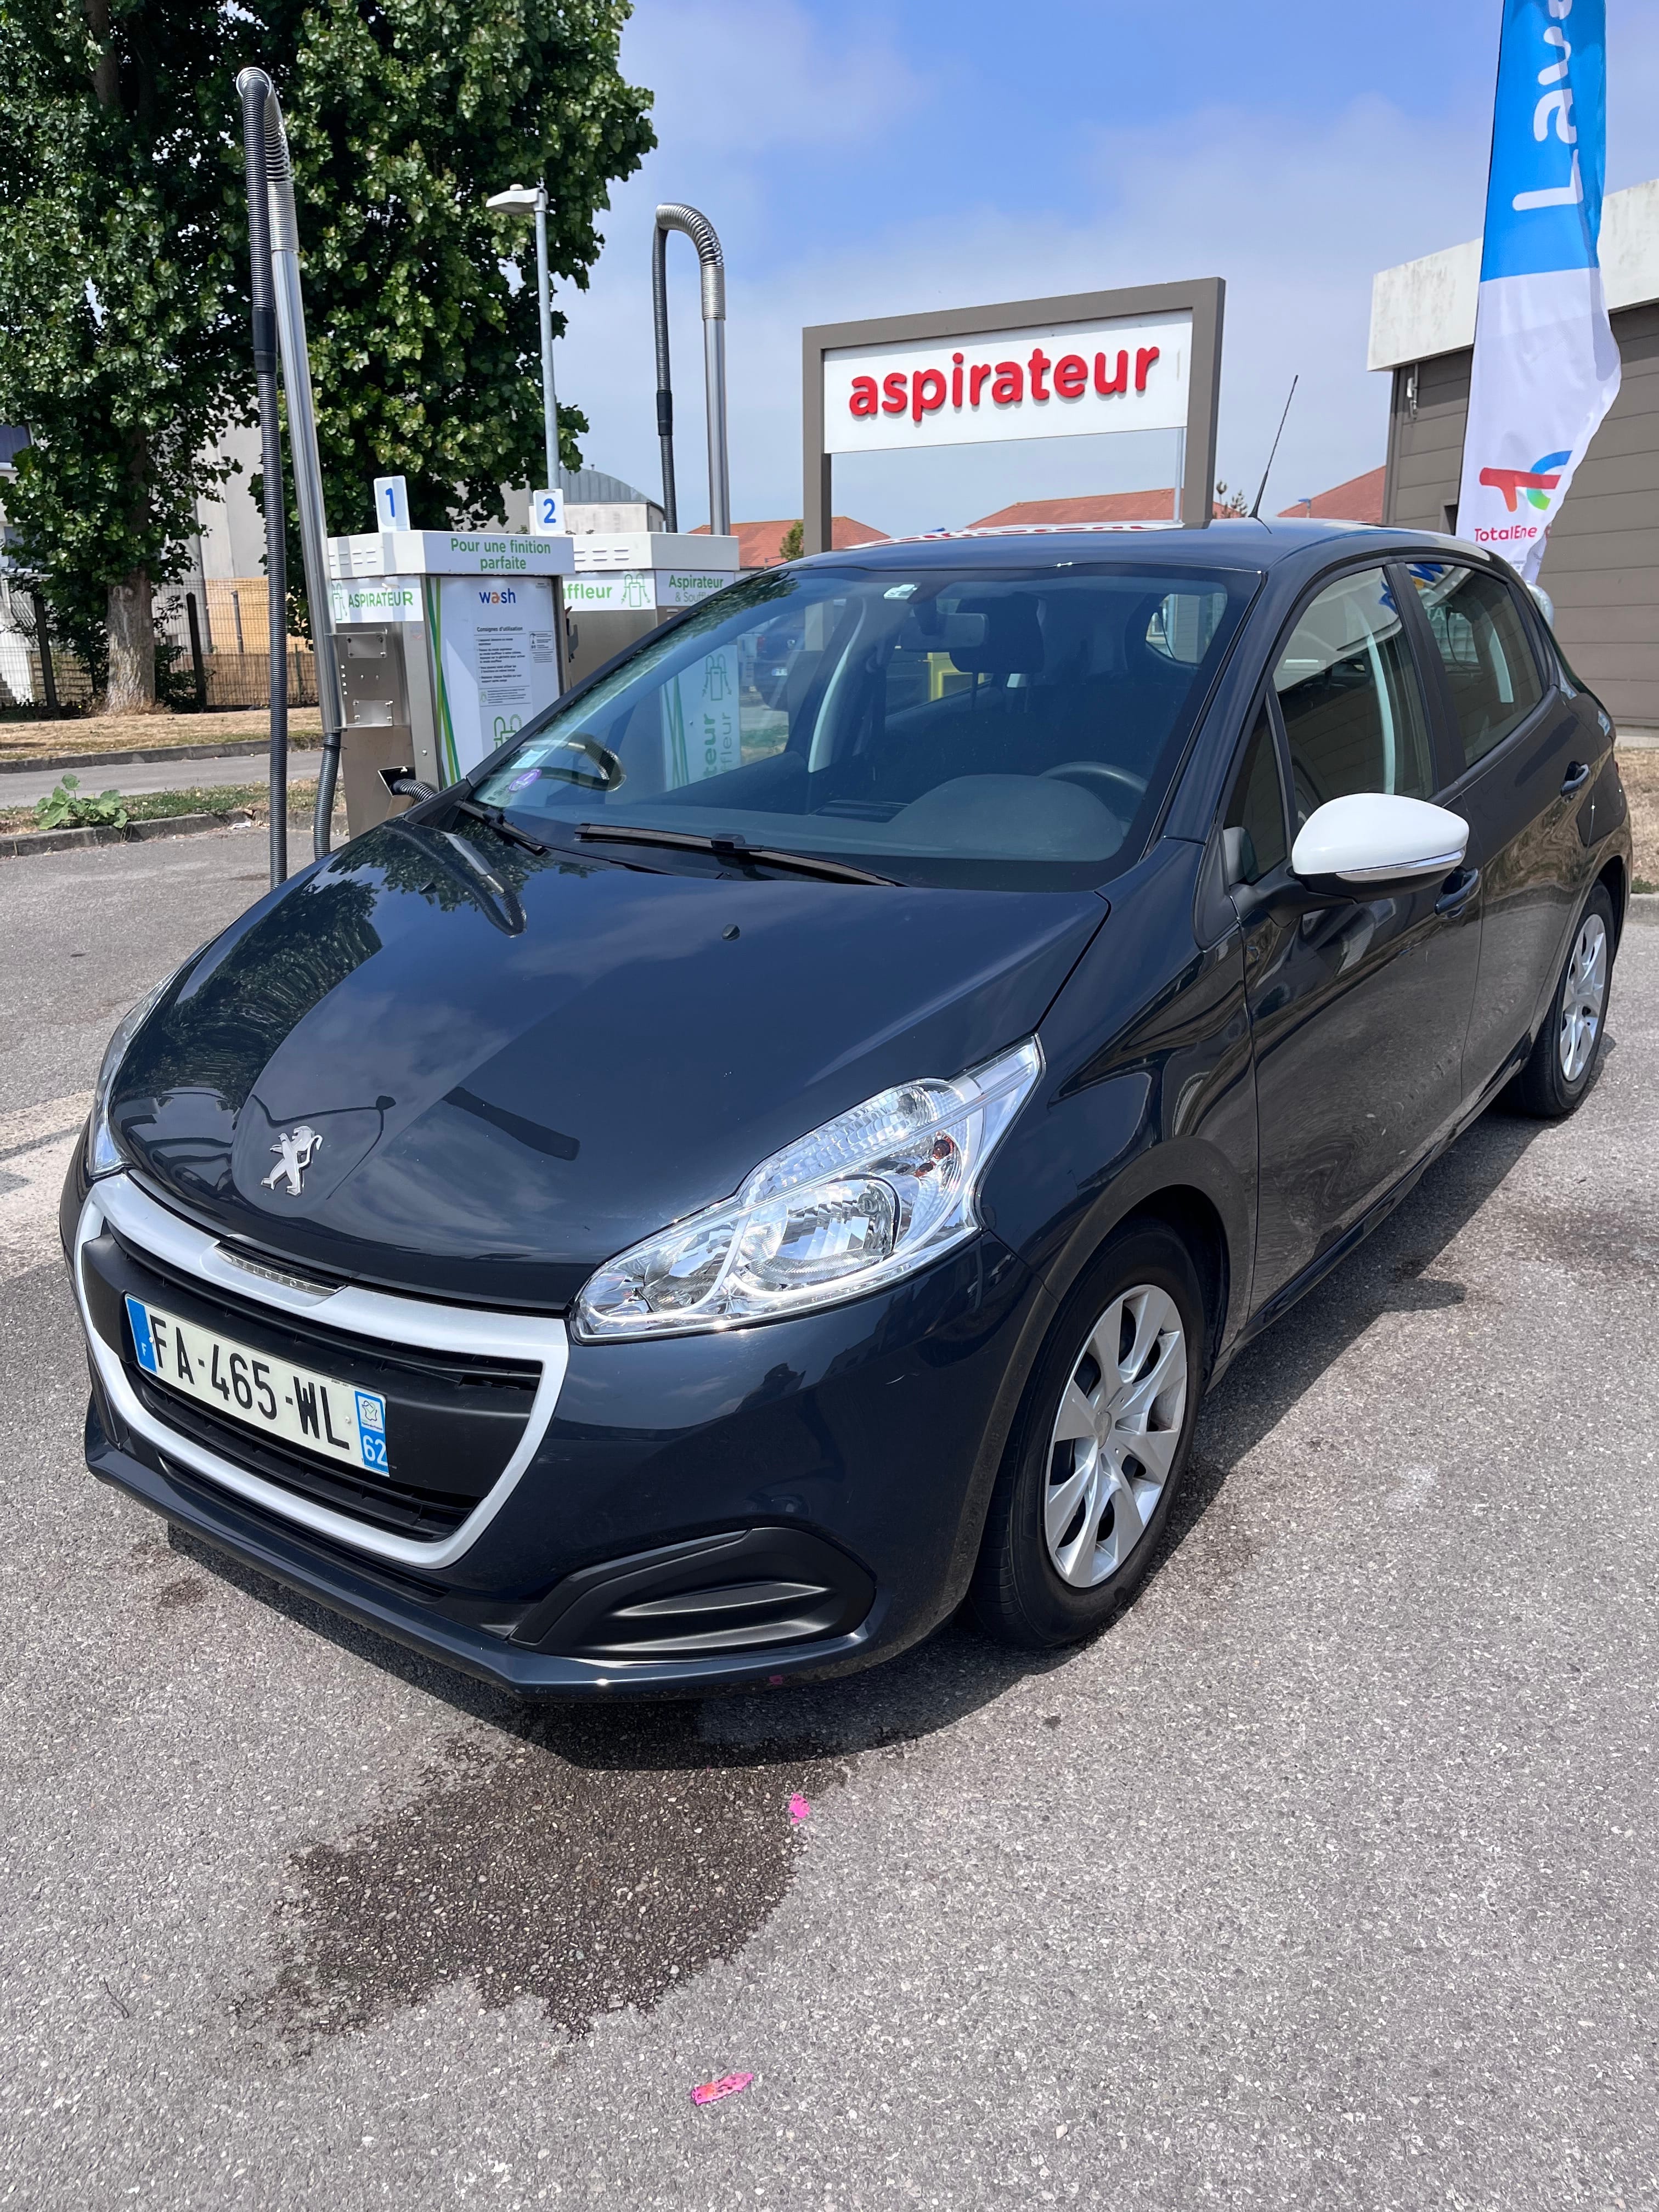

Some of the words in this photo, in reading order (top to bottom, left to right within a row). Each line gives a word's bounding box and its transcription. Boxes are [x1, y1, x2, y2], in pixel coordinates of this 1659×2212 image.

[849, 346, 1160, 422] aspirateur
[385, 487, 396, 517] 1
[543, 498, 556, 523] 2
[451, 538, 480, 552] Pour
[484, 541, 506, 553] une
[510, 539, 551, 554] finition
[480, 556, 527, 571] parfaite
[669, 574, 724, 591] Aspirateur
[348, 591, 414, 608] ASPIRATEUR
[479, 588, 516, 604] wash
[141, 1342, 147, 1357] F
[149, 1314, 351, 1451] FA-465-WL
[363, 1435, 388, 1466] 62
